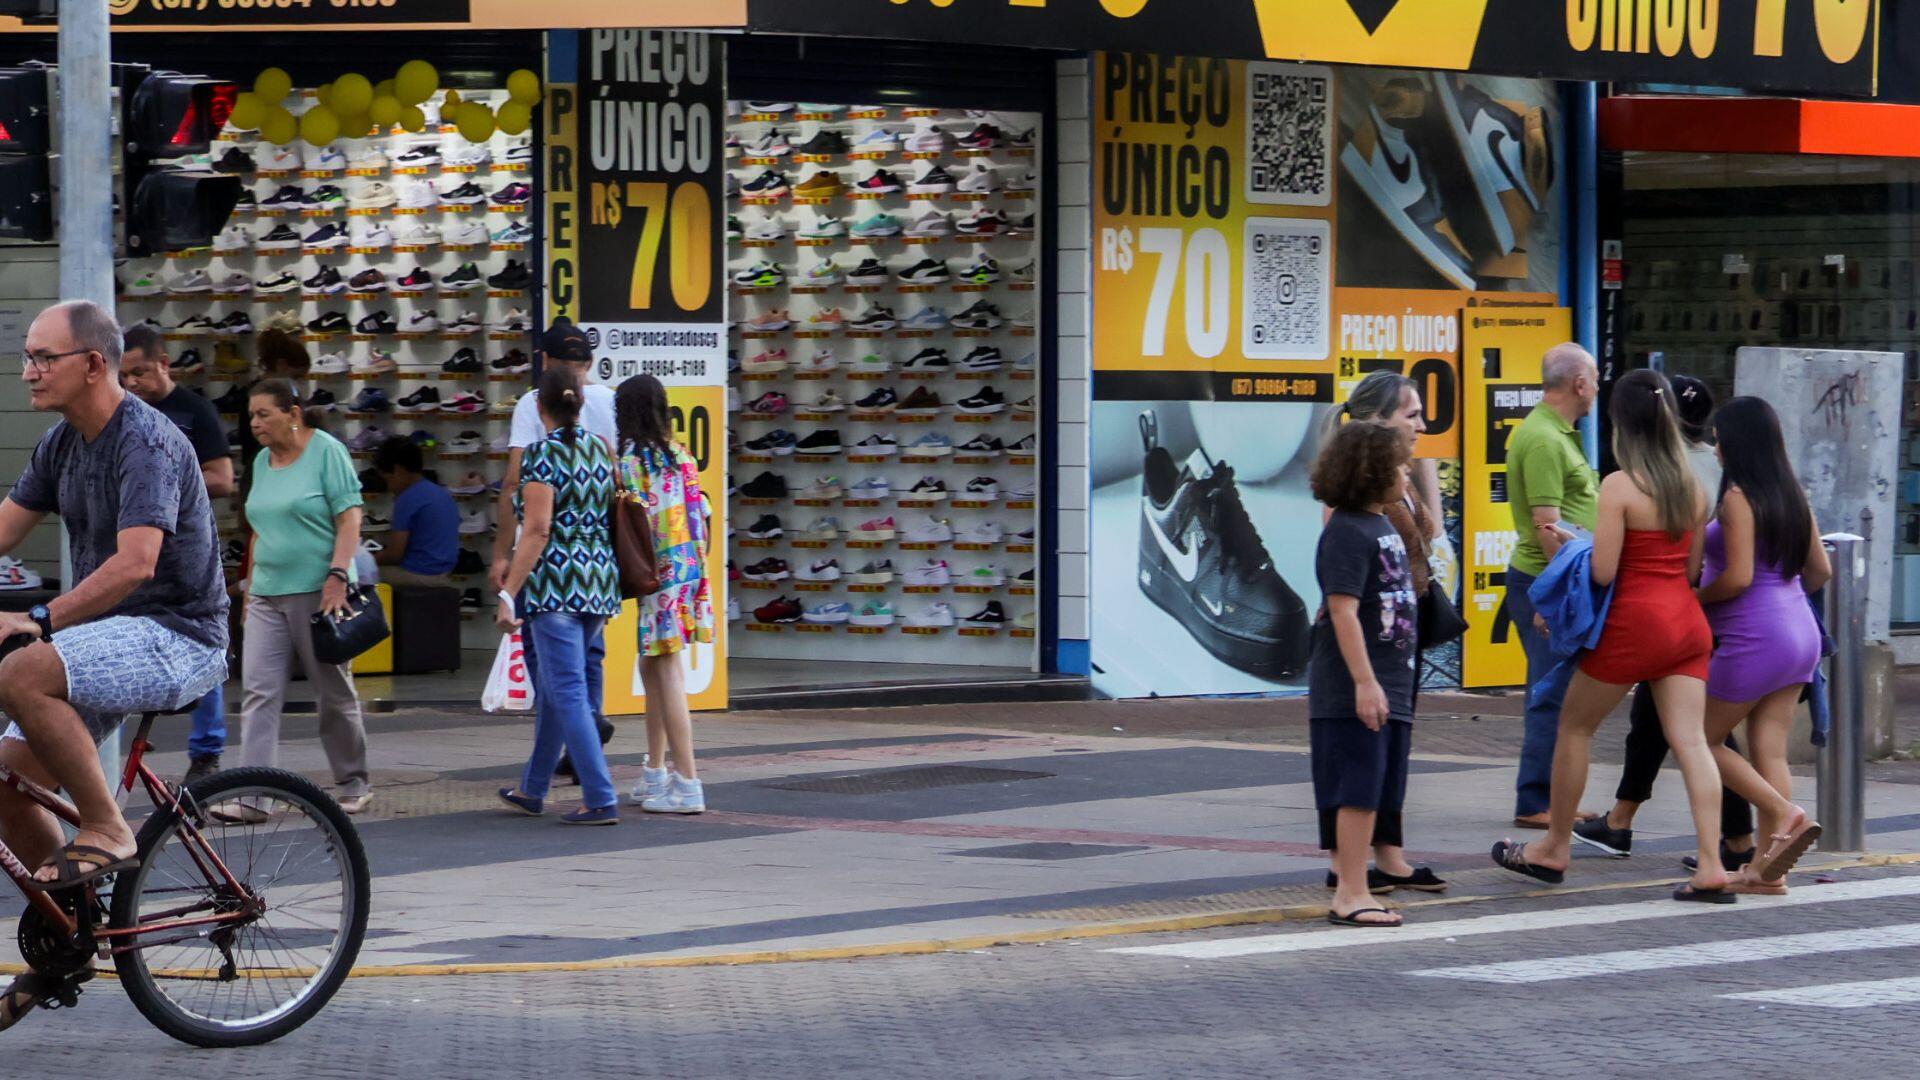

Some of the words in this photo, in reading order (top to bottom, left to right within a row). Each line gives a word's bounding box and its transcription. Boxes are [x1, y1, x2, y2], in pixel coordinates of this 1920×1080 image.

[591, 29, 710, 98] PREÇO
[1103, 53, 1230, 139] PREÇO
[590, 85, 712, 174] ÚNICO
[1103, 126, 1231, 220] ÚNICO
[551, 87, 574, 328] PREÇ
[591, 180, 622, 228] R$
[626, 181, 712, 311] 70
[1102, 226, 1134, 275] R$
[1139, 227, 1231, 359] 70
[1341, 313, 1398, 359] PREÇO
[1403, 307, 1458, 353] ÚNICO
